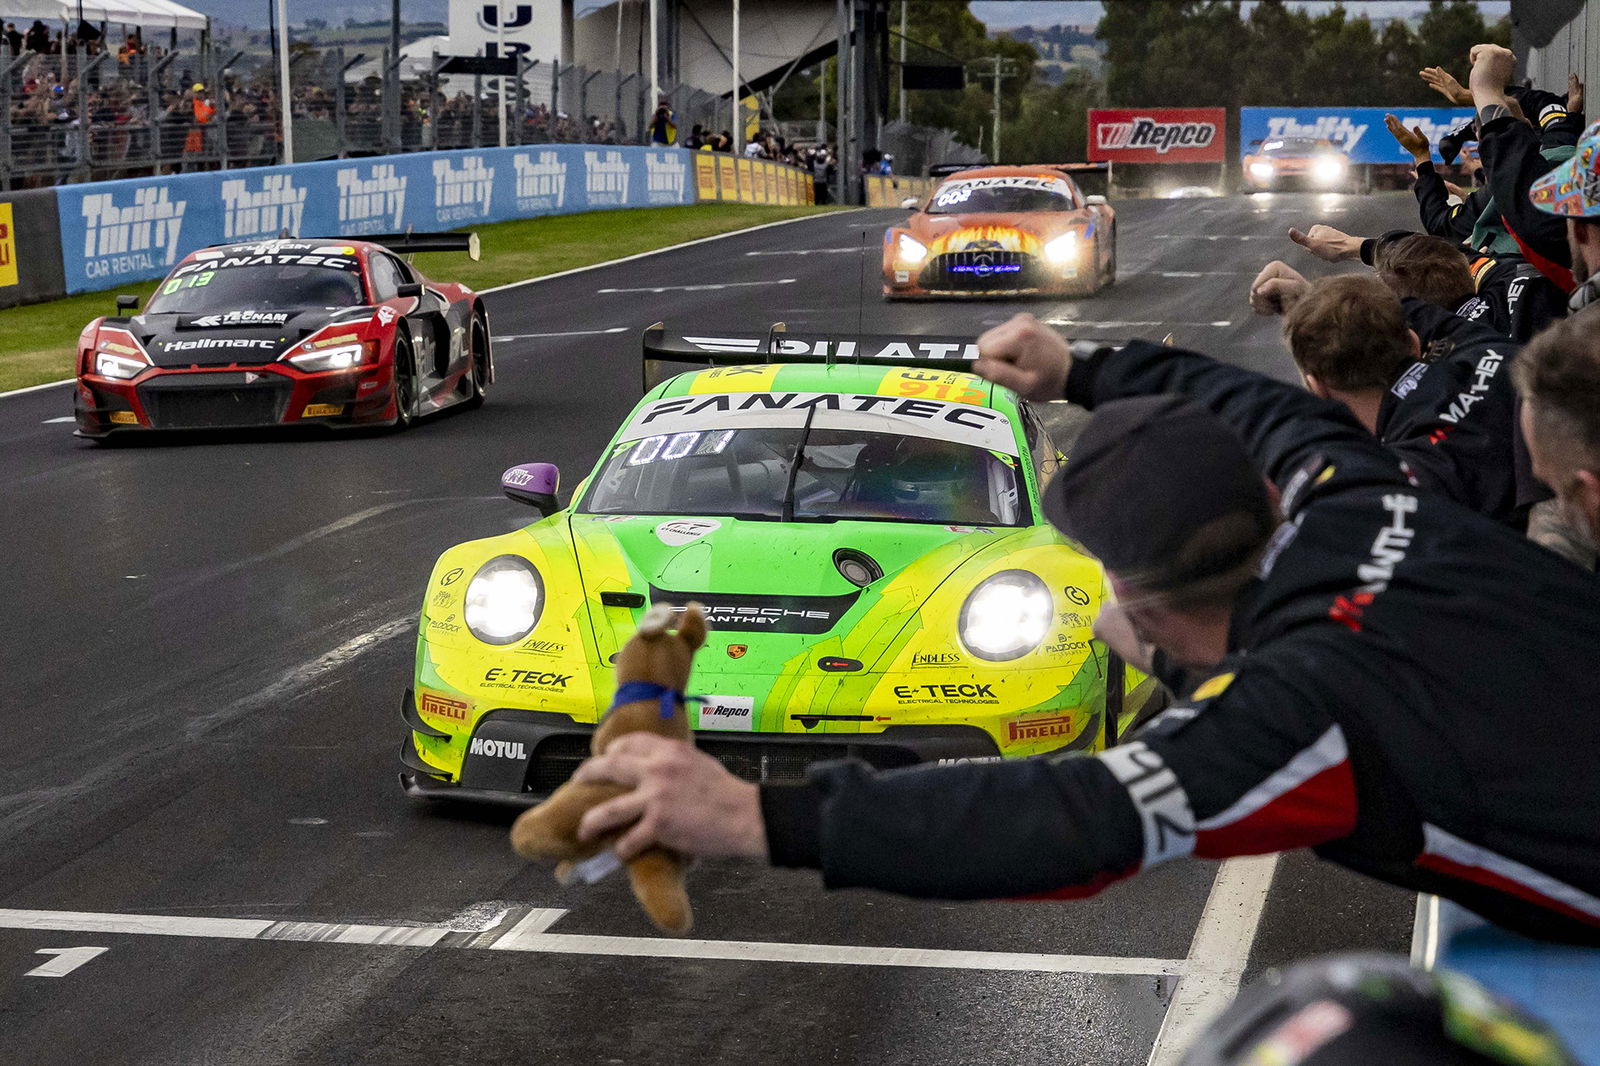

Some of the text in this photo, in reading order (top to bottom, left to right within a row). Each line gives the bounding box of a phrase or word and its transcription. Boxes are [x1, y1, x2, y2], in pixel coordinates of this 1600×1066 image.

[1128, 118, 1215, 152] Repco
[432, 156, 495, 216] Thrifty
[513, 151, 567, 208] Thrifty
[584, 150, 630, 204] Thrifty
[645, 152, 686, 203] Thrifty
[945, 177, 1057, 192] FANATEC
[221, 175, 308, 239] Thrifty
[336, 164, 407, 229] Thrifty
[82, 186, 188, 265] Thrifty
[85, 253, 155, 279] CAR RENTAL
[173, 254, 352, 278] FANATEC
[163, 338, 276, 353] Hallmarc
[899, 381, 987, 406] 912
[640, 393, 997, 430] FANATEC
[704, 615, 780, 624] ANTHEY
[522, 639, 568, 653] ENDLESS
[911, 651, 961, 666] ENDLESS
[1045, 641, 1088, 653] PADDOCK
[479, 682, 565, 694] ELECTRICAL TECHNOLOGIES
[421, 692, 468, 721] PIRELLI
[713, 705, 750, 718] Repco
[1008, 715, 1072, 741] PIRELLI
[470, 736, 527, 761] MOTUL
